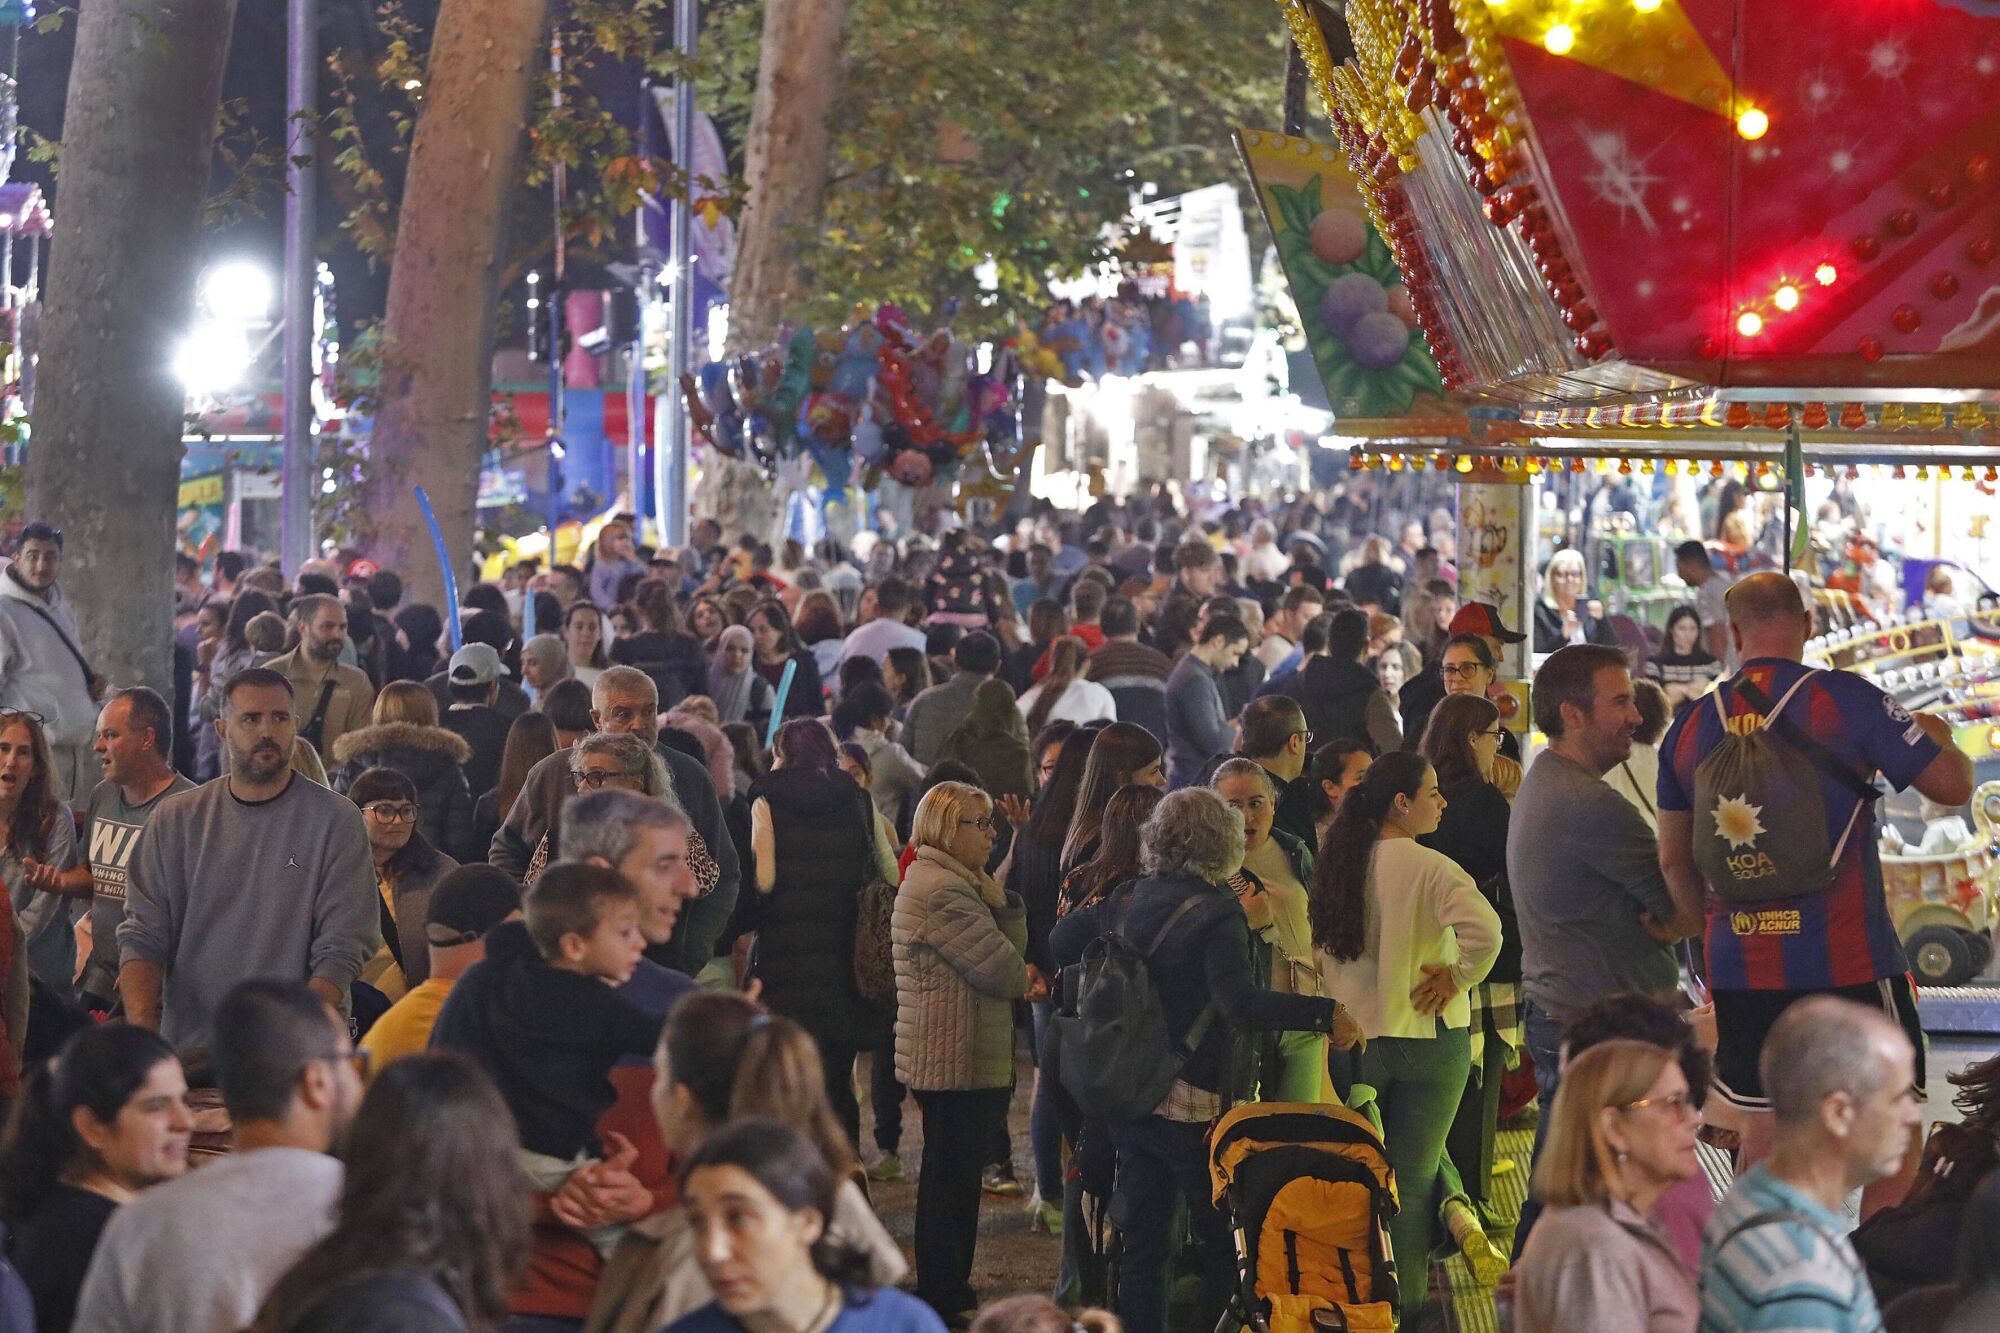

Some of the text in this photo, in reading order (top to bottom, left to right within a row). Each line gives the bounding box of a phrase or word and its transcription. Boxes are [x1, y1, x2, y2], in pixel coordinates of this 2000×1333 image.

[1726, 852, 1774, 870] KOA
[91, 867, 127, 882] SHING
[1757, 910, 1800, 921] UNHCR
[1759, 920, 1800, 931] ACNUR
